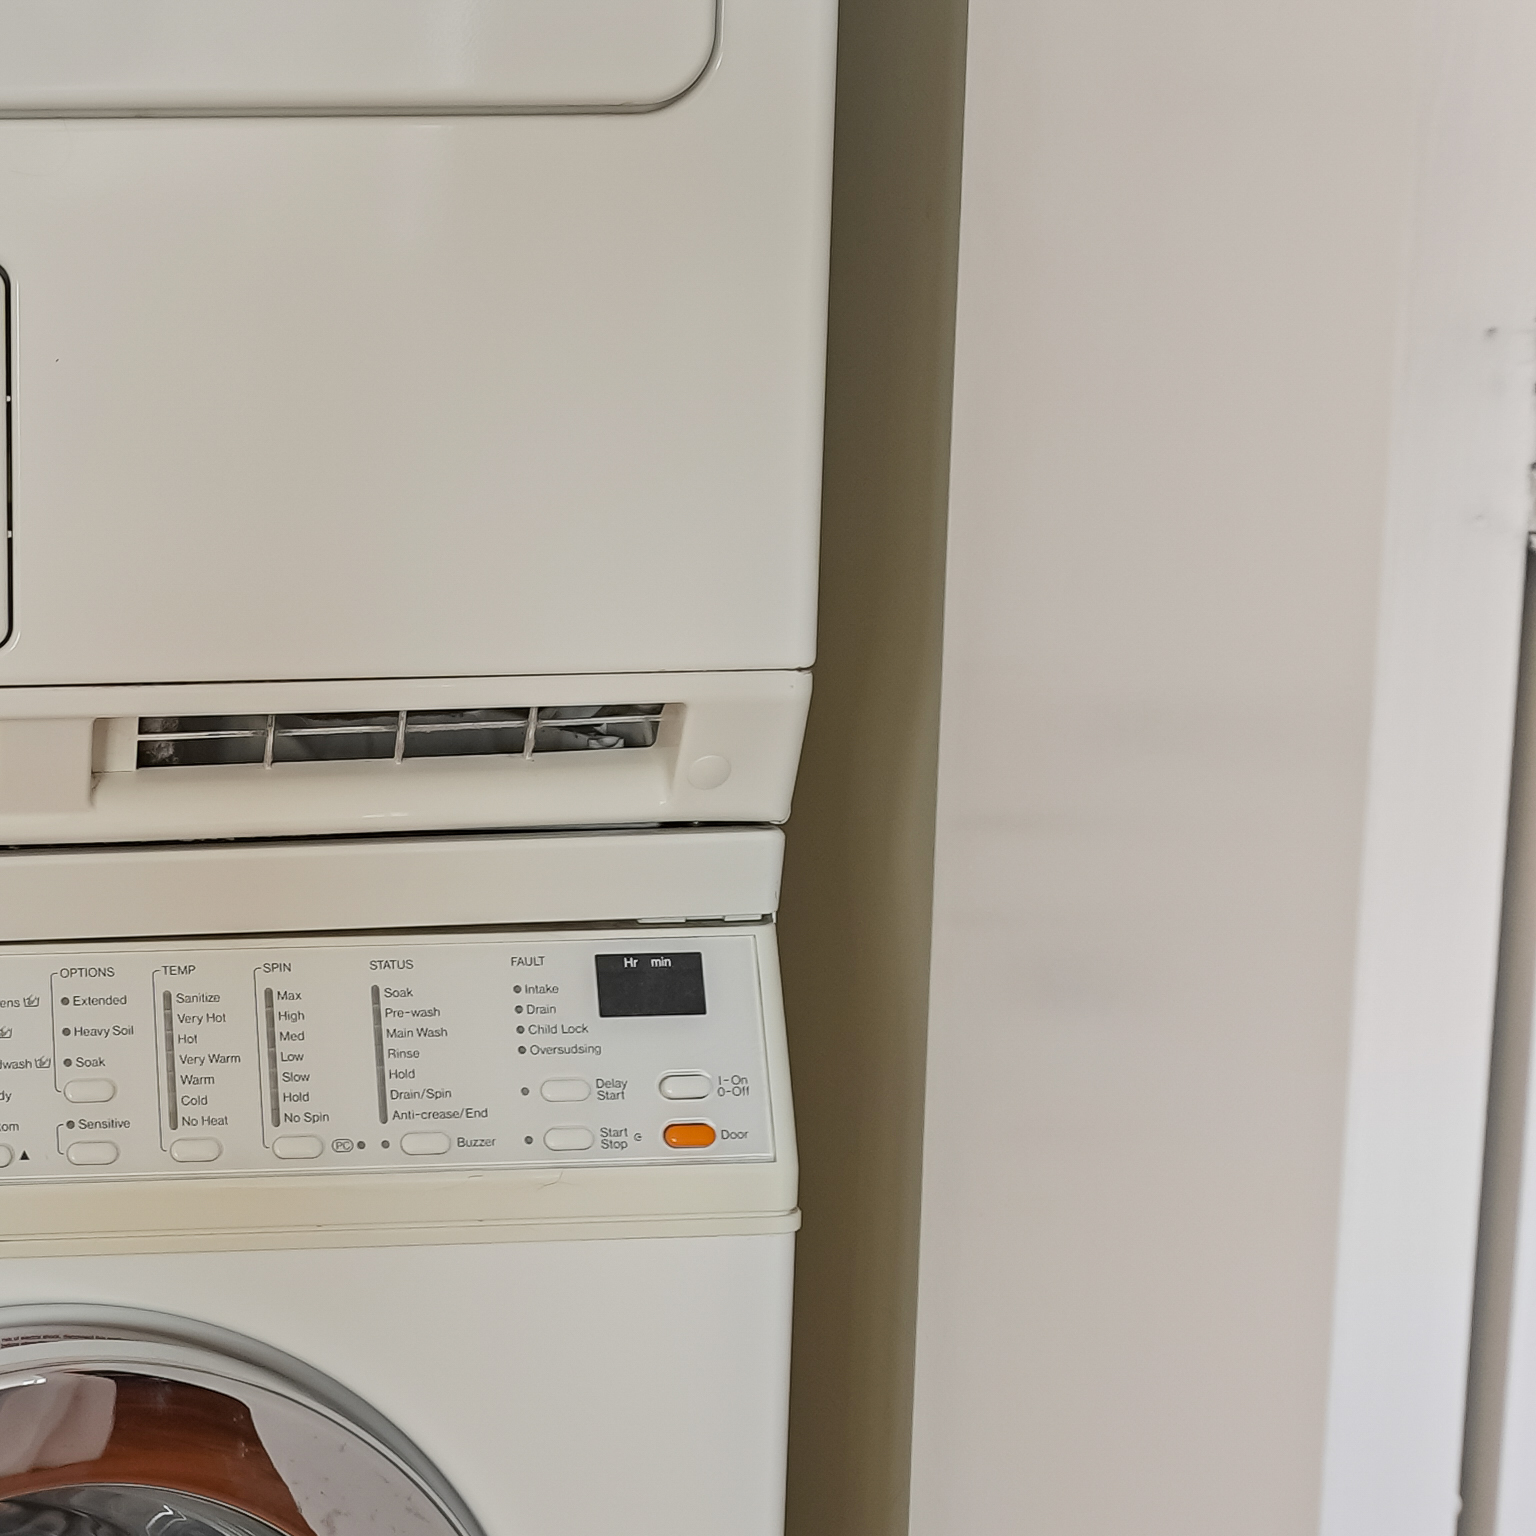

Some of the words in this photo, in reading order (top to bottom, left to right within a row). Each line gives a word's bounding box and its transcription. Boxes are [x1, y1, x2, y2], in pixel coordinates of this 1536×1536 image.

[369, 958, 415, 971] STATUS
[510, 955, 546, 967] FAULT
[623, 956, 639, 968] Hr
[650, 956, 672, 968] min
[59, 966, 116, 979] OPTIONS
[160, 964, 197, 976] TEMP
[262, 962, 292, 974] SPIN
[383, 987, 414, 999] Soak
[524, 983, 560, 995] Intake
[72, 994, 128, 1007] Extended
[175, 992, 221, 1004] Sanitize
[276, 990, 302, 1001] Max
[384, 1006, 441, 1019] Pre-wash
[526, 1003, 557, 1015] Drain
[176, 1013, 204, 1026] Very
[205, 1012, 227, 1023] Hot
[278, 1010, 305, 1023] High
[73, 1026, 110, 1039] Heavy
[111, 1024, 135, 1036] Soil
[385, 1028, 414, 1039] Main
[415, 1027, 448, 1038] Wash
[527, 1023, 558, 1036] Child
[560, 1023, 589, 1035] Lock
[177, 1033, 198, 1045] Hot
[279, 1030, 305, 1042] Med
[387, 1048, 420, 1059] Rinse
[529, 1043, 602, 1056] Oversudsing
[75, 1056, 106, 1068] Soak
[178, 1053, 206, 1067] Very
[207, 1053, 241, 1064] Warm
[280, 1051, 305, 1063] Low
[179, 1074, 215, 1086] Warm
[281, 1071, 311, 1083] Slow
[388, 1068, 416, 1080] Hold
[596, 1078, 628, 1091] Delay
[180, 1094, 208, 1107] Cold
[282, 1091, 310, 1103] Hold
[389, 1088, 452, 1101] Drain/Spin
[596, 1090, 626, 1101] Start
[283, 1112, 301, 1124] No
[303, 1111, 330, 1124] Spin
[391, 1107, 489, 1121] Anti-crease/End
[77, 1118, 131, 1130] Sensitive
[181, 1115, 199, 1127] No
[200, 1115, 229, 1127] Heat
[600, 1127, 629, 1138] Start
[720, 1129, 749, 1141] Door
[456, 1136, 497, 1148] Buzzer
[600, 1138, 629, 1151] Stop
